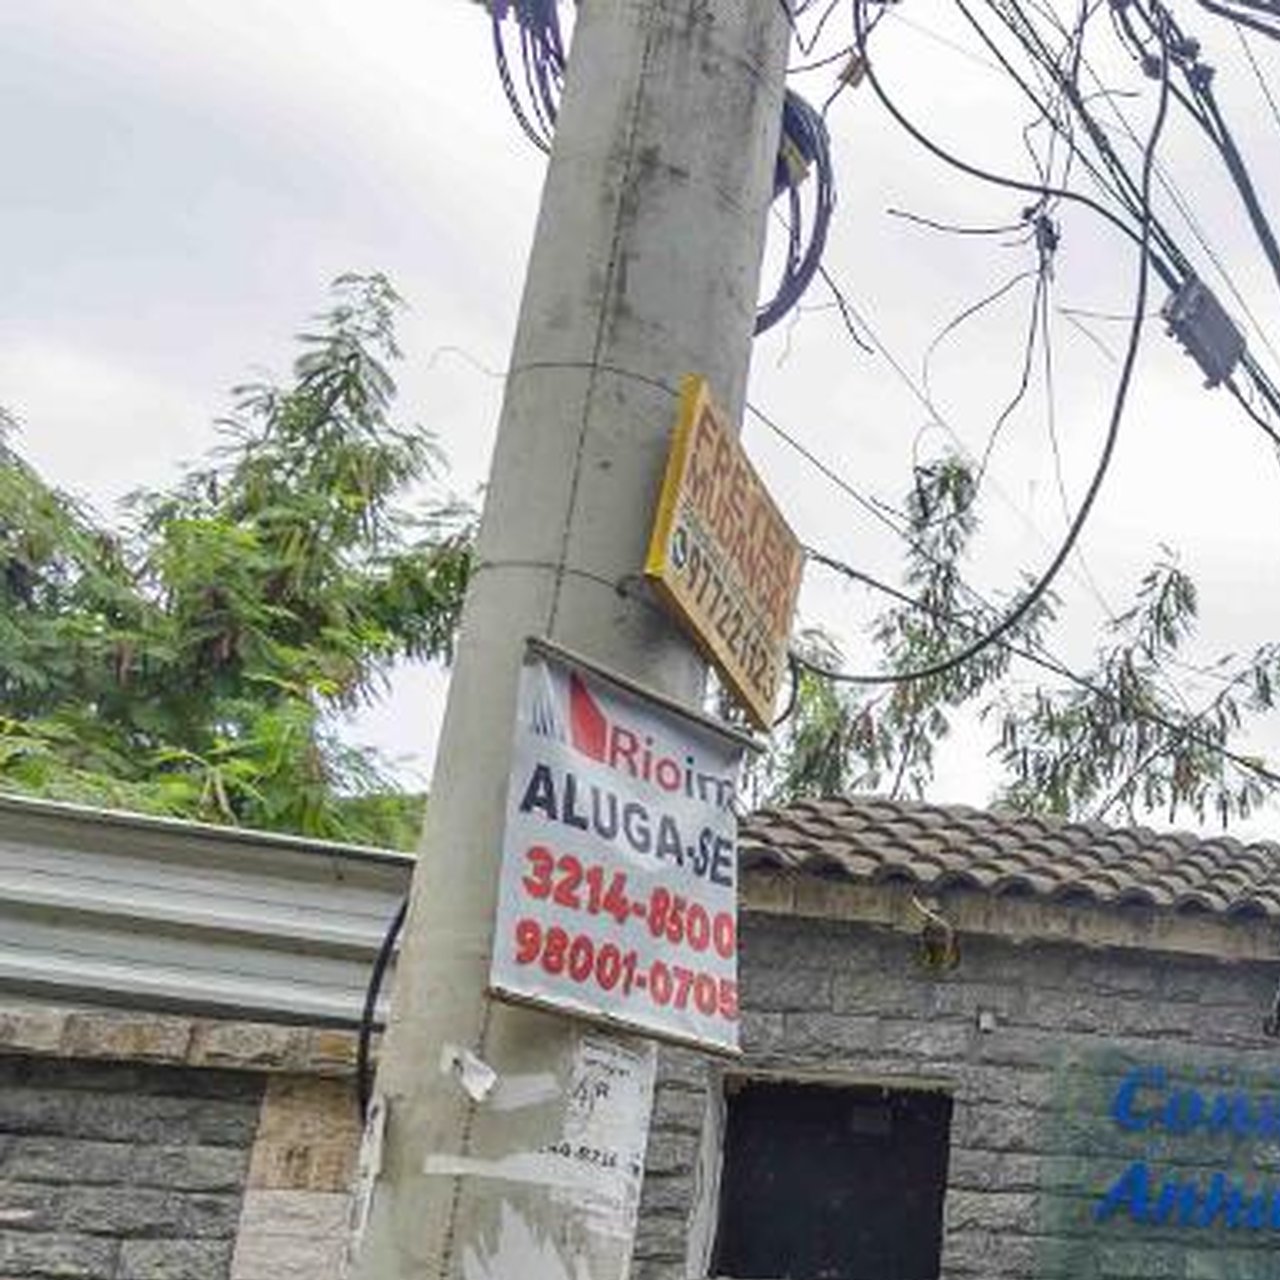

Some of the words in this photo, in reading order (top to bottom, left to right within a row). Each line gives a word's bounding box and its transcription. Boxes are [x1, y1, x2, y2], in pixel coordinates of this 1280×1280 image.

[518, 763, 735, 888] ALUGA-SE
[521, 845, 738, 960] 3214-8500
[514, 918, 741, 1022] 98001-0705
